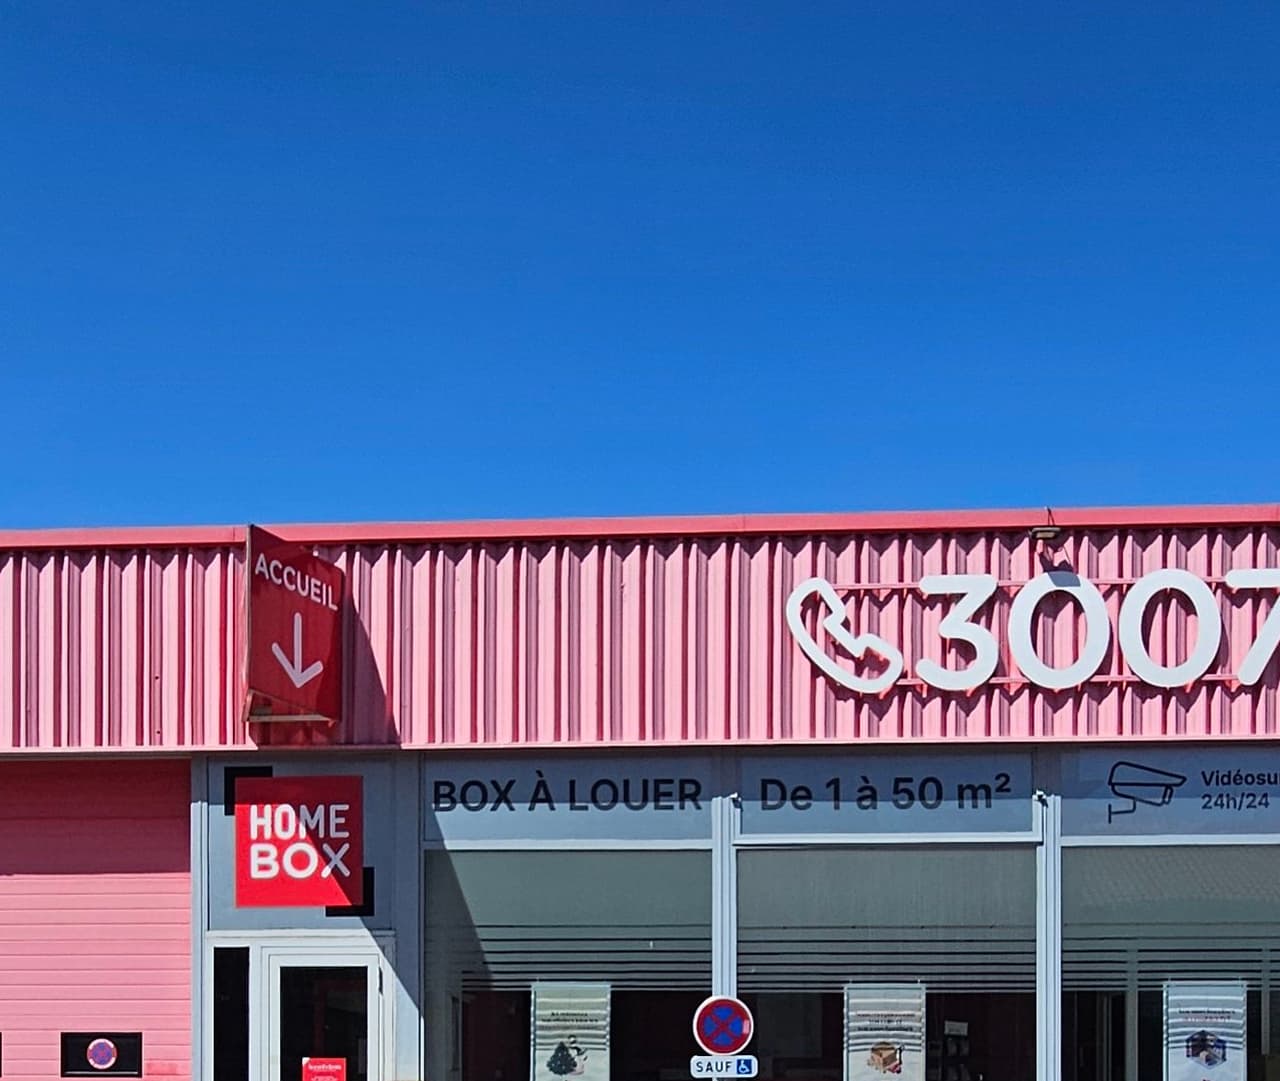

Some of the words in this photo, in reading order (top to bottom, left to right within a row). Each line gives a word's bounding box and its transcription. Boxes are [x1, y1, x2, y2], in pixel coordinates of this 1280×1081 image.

[254, 553, 339, 612] ACCUEIL
[433, 779, 516, 811] BOX
[528, 769, 556, 811] À
[569, 778, 702, 811] LOUER
[760, 778, 813, 811] De
[825, 777, 840, 811] 1
[856, 776, 878, 811] à
[892, 776, 943, 810] 50
[1201, 792, 1270, 811] 24h/24
[250, 804, 350, 840] HOME
[250, 842, 351, 879] BOX
[696, 1061, 732, 1073] SAUF
